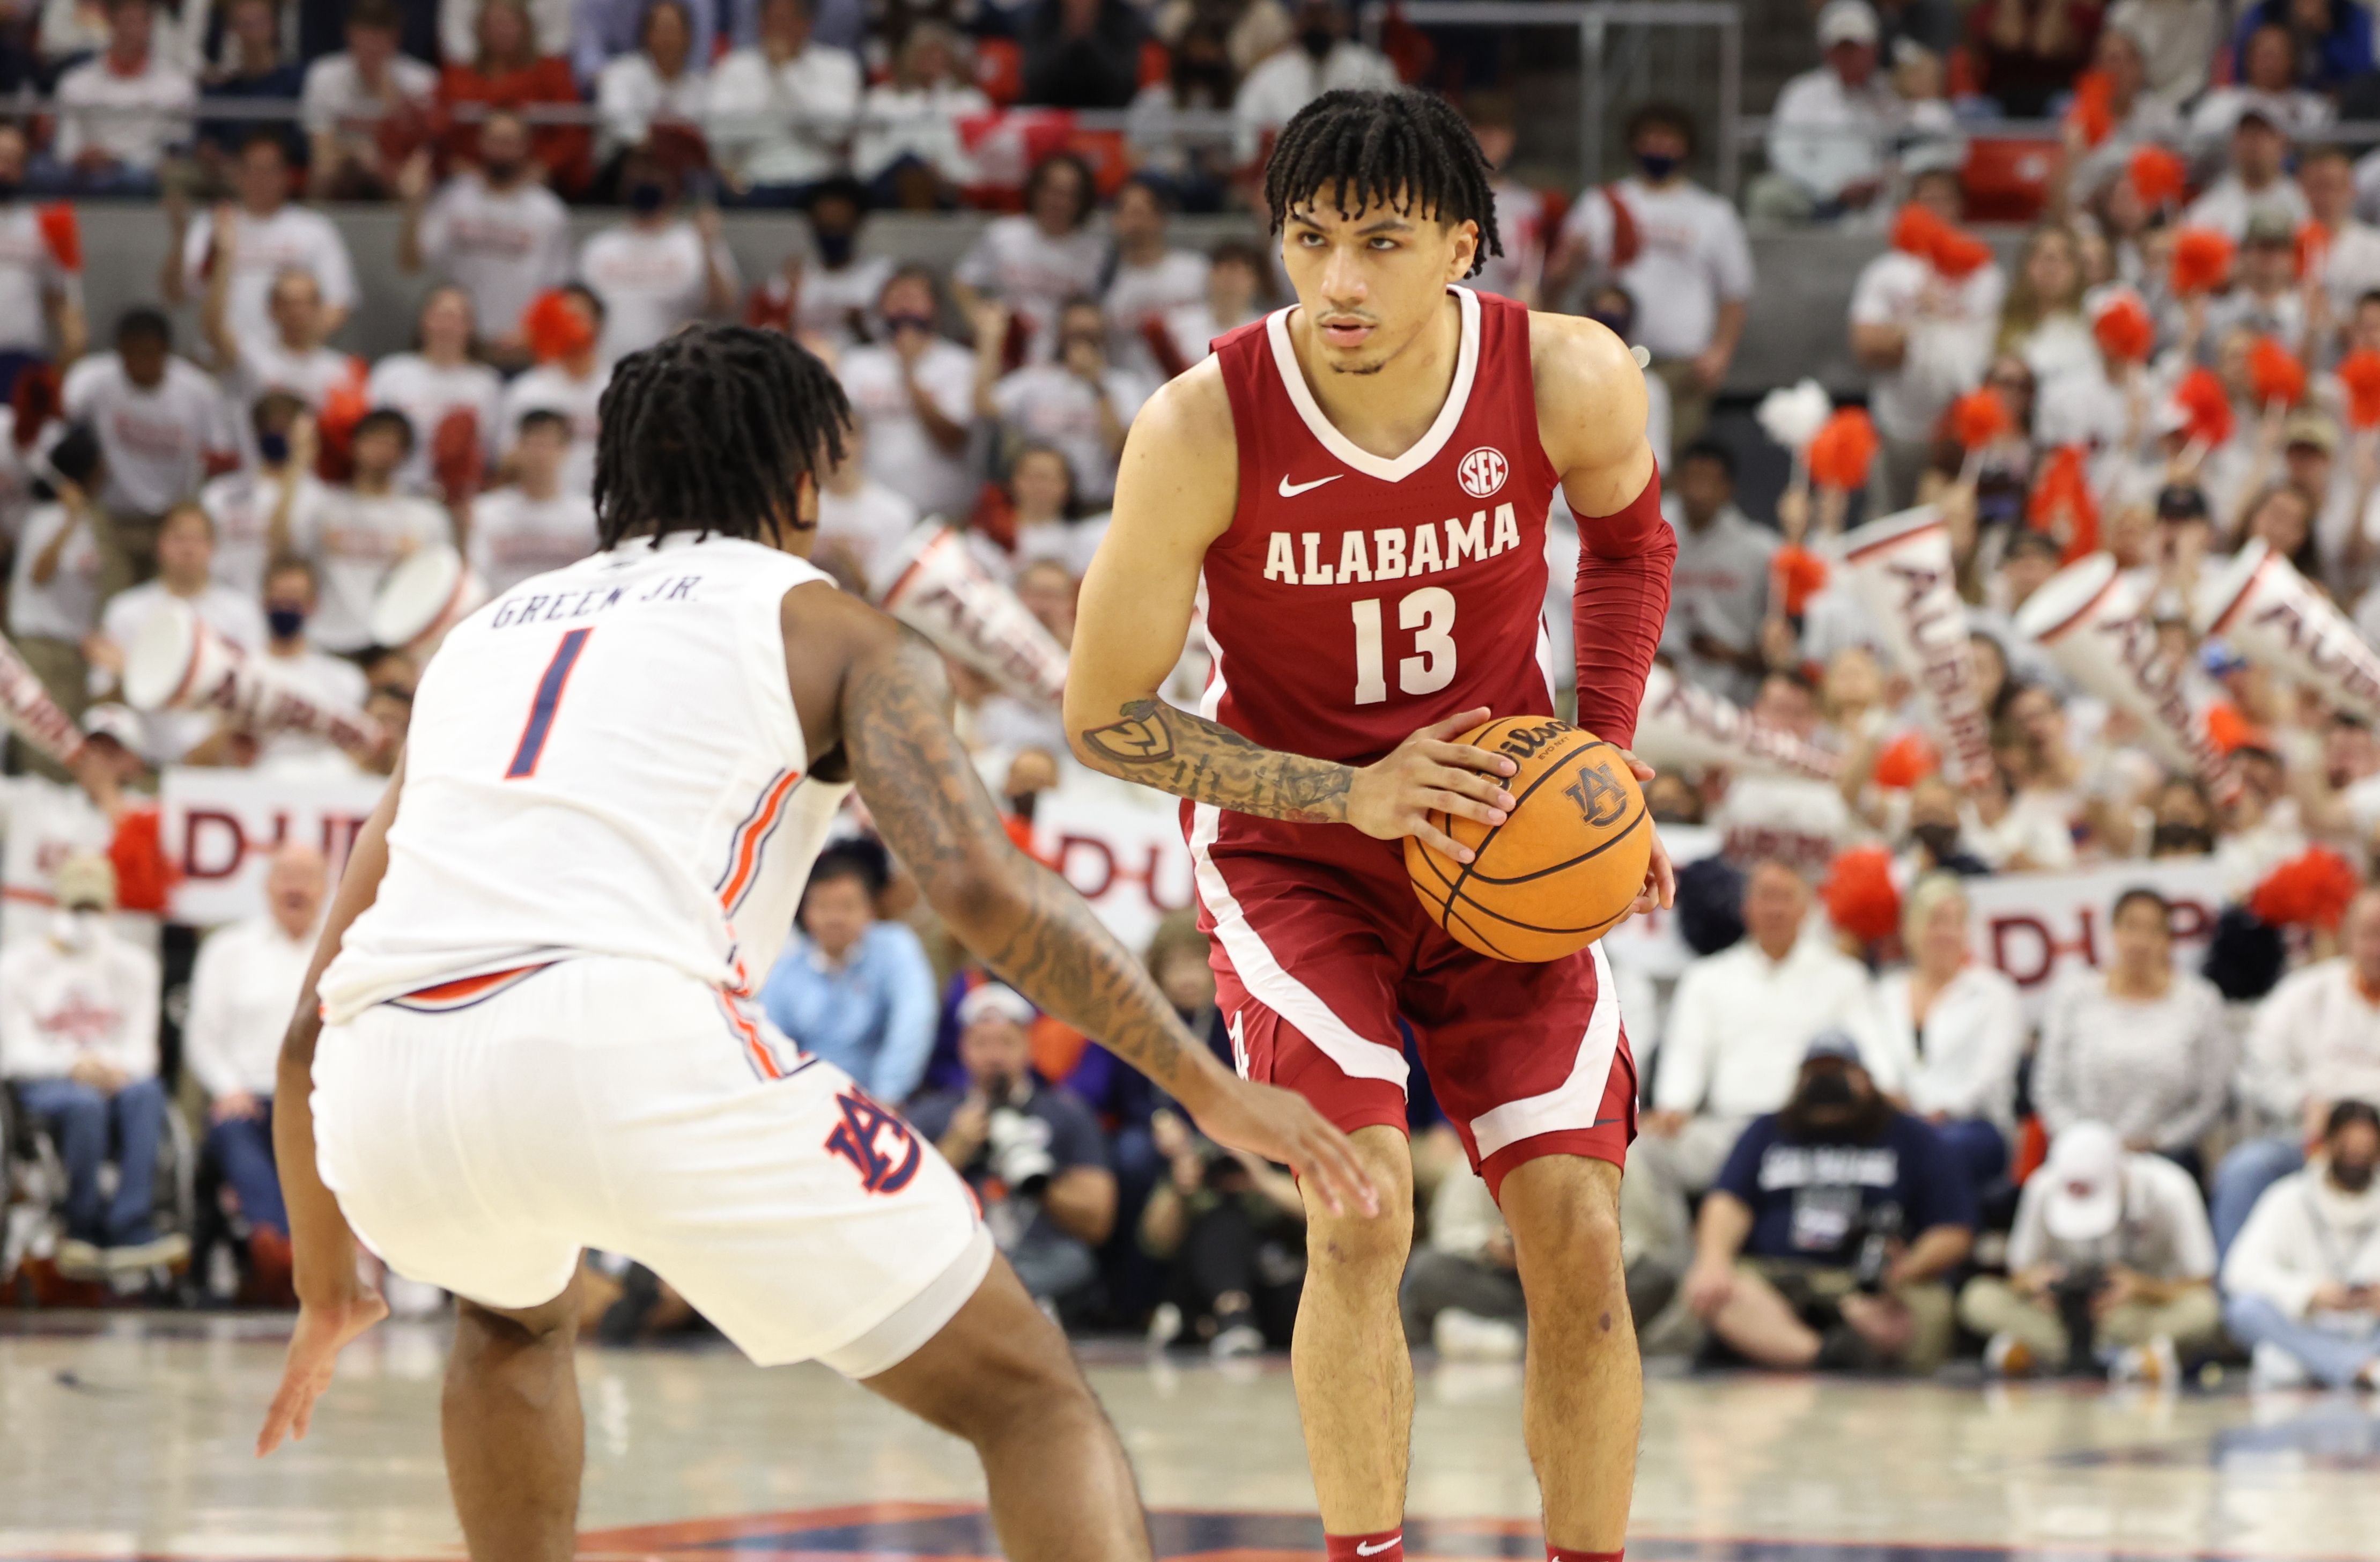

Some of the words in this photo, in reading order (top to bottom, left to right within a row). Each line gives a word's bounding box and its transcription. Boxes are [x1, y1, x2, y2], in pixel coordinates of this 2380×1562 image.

[1461, 451, 1504, 495] SEC
[1263, 502, 1520, 585] ALABAMA
[491, 586, 631, 629] GREEN
[1351, 586, 1458, 705] 13
[503, 627, 595, 780] 1
[1538, 746, 1555, 761] EVO
[1554, 736, 1571, 748] NXT
